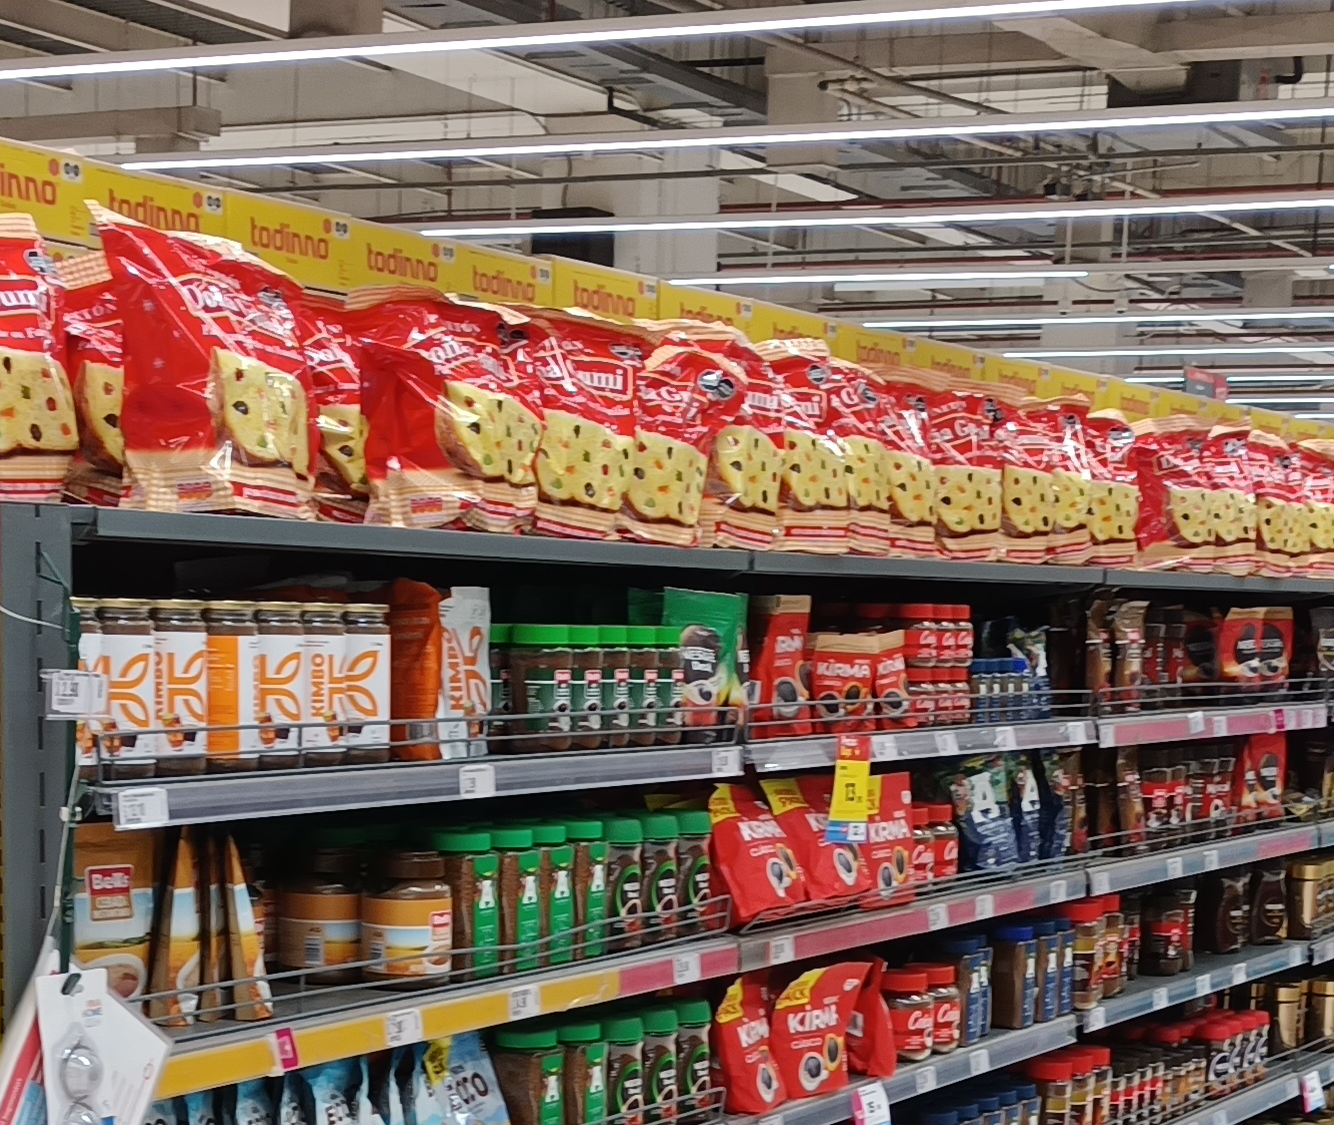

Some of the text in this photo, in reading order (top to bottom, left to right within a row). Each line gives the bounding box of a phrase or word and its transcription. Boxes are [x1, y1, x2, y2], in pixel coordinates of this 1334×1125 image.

[250, 216, 330, 260] todinno
[367, 243, 439, 283] todinno
[310, 653, 327, 718] KIMBO
